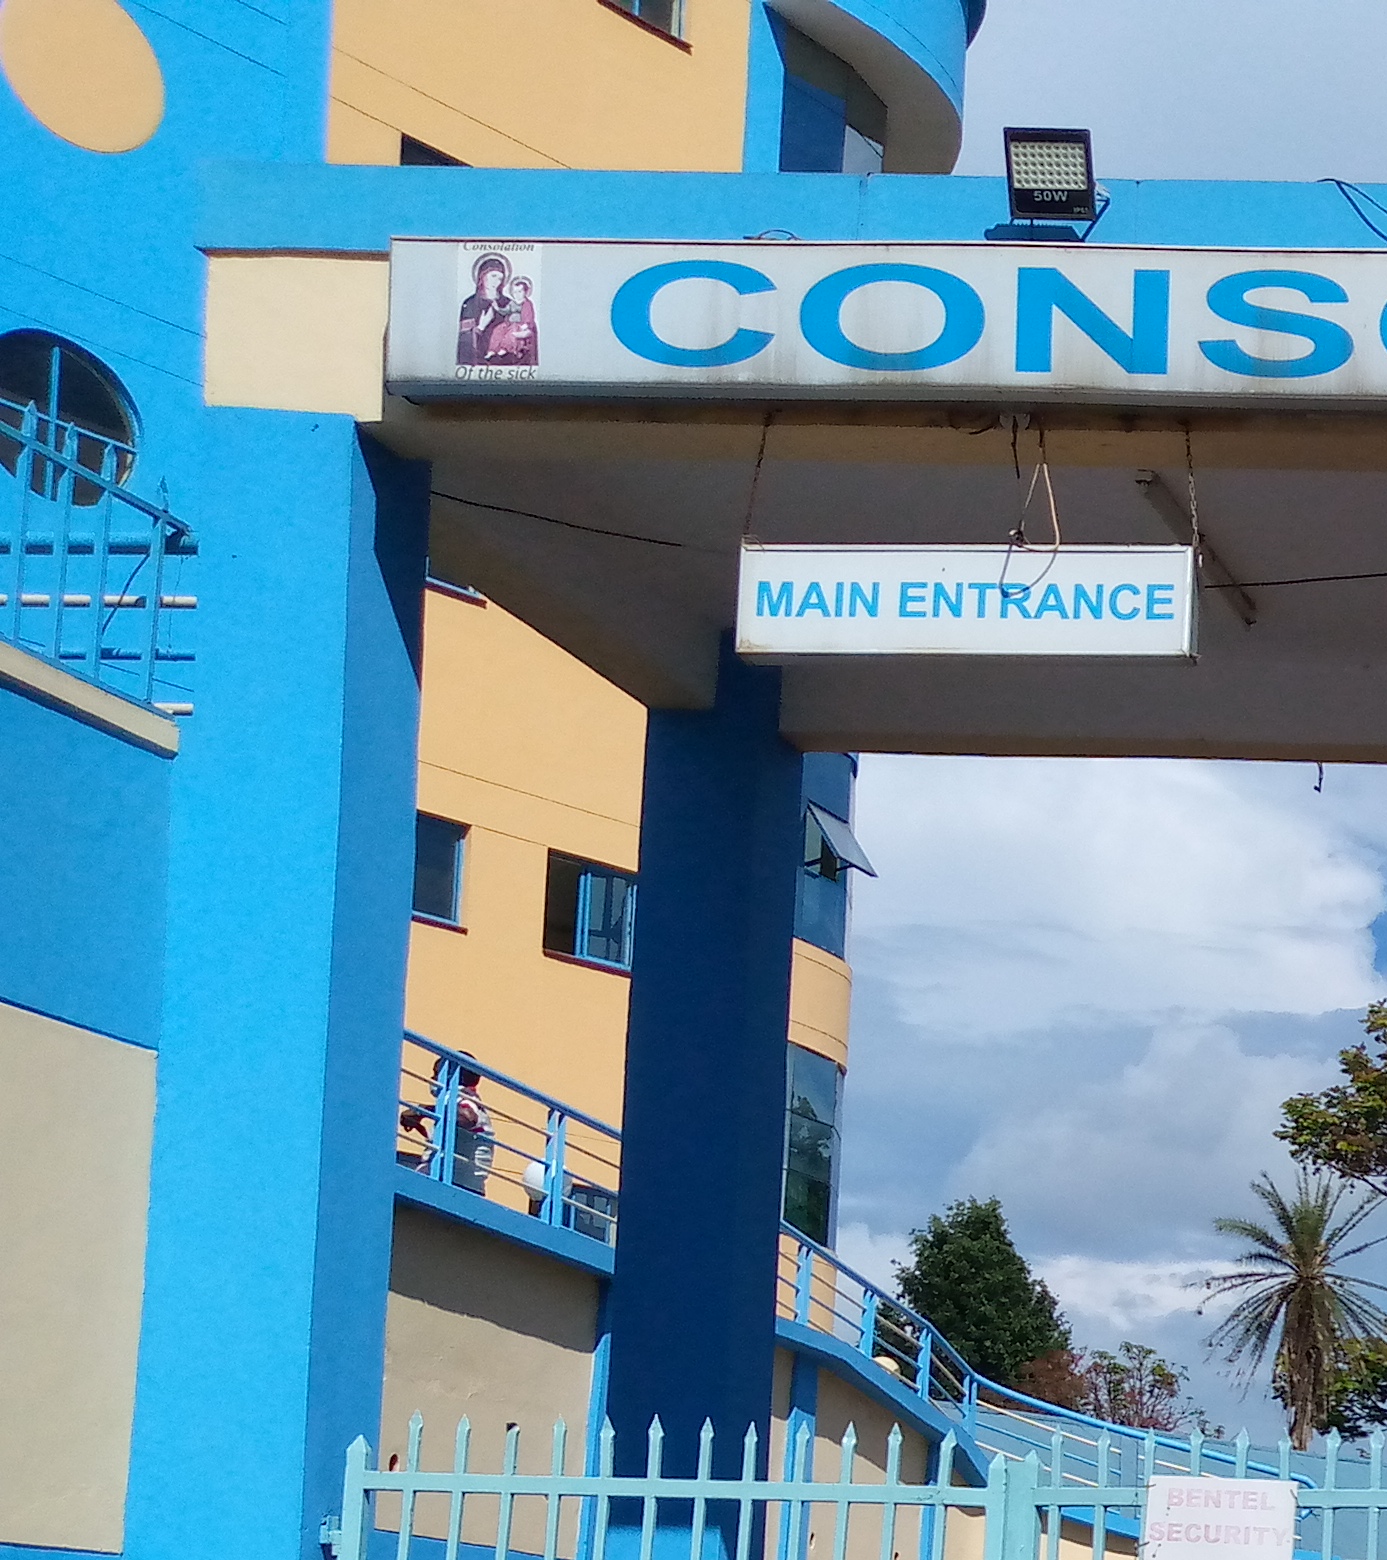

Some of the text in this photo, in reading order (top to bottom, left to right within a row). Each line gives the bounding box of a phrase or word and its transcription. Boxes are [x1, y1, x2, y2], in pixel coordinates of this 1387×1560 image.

[1033, 191, 1068, 202] 50W
[455, 366, 537, 380] Of the sick
[754, 581, 1175, 623] MAIN ENTRANCE
[1168, 1488, 1276, 1511] BENTEL
